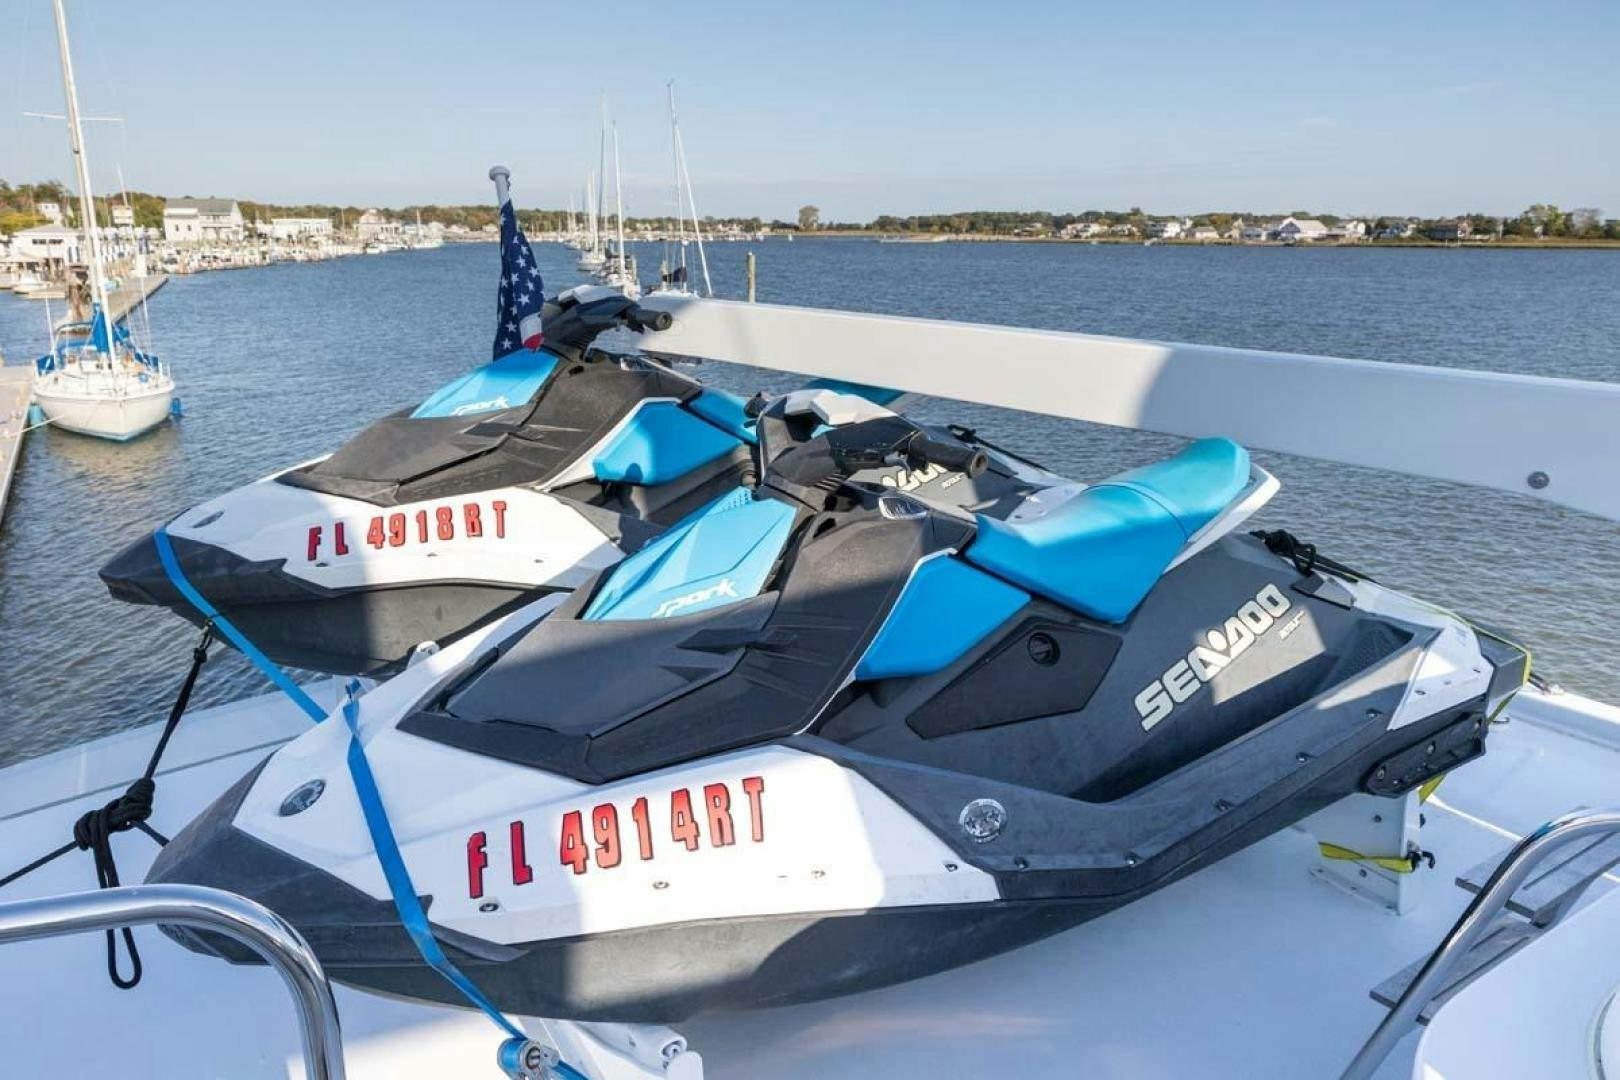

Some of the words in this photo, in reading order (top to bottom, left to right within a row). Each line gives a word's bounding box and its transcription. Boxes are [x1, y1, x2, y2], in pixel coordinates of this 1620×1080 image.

[307, 521, 349, 562] FL
[367, 500, 506, 549] 4918RT
[467, 820, 533, 899] FL
[560, 776, 764, 875] 4914RT
